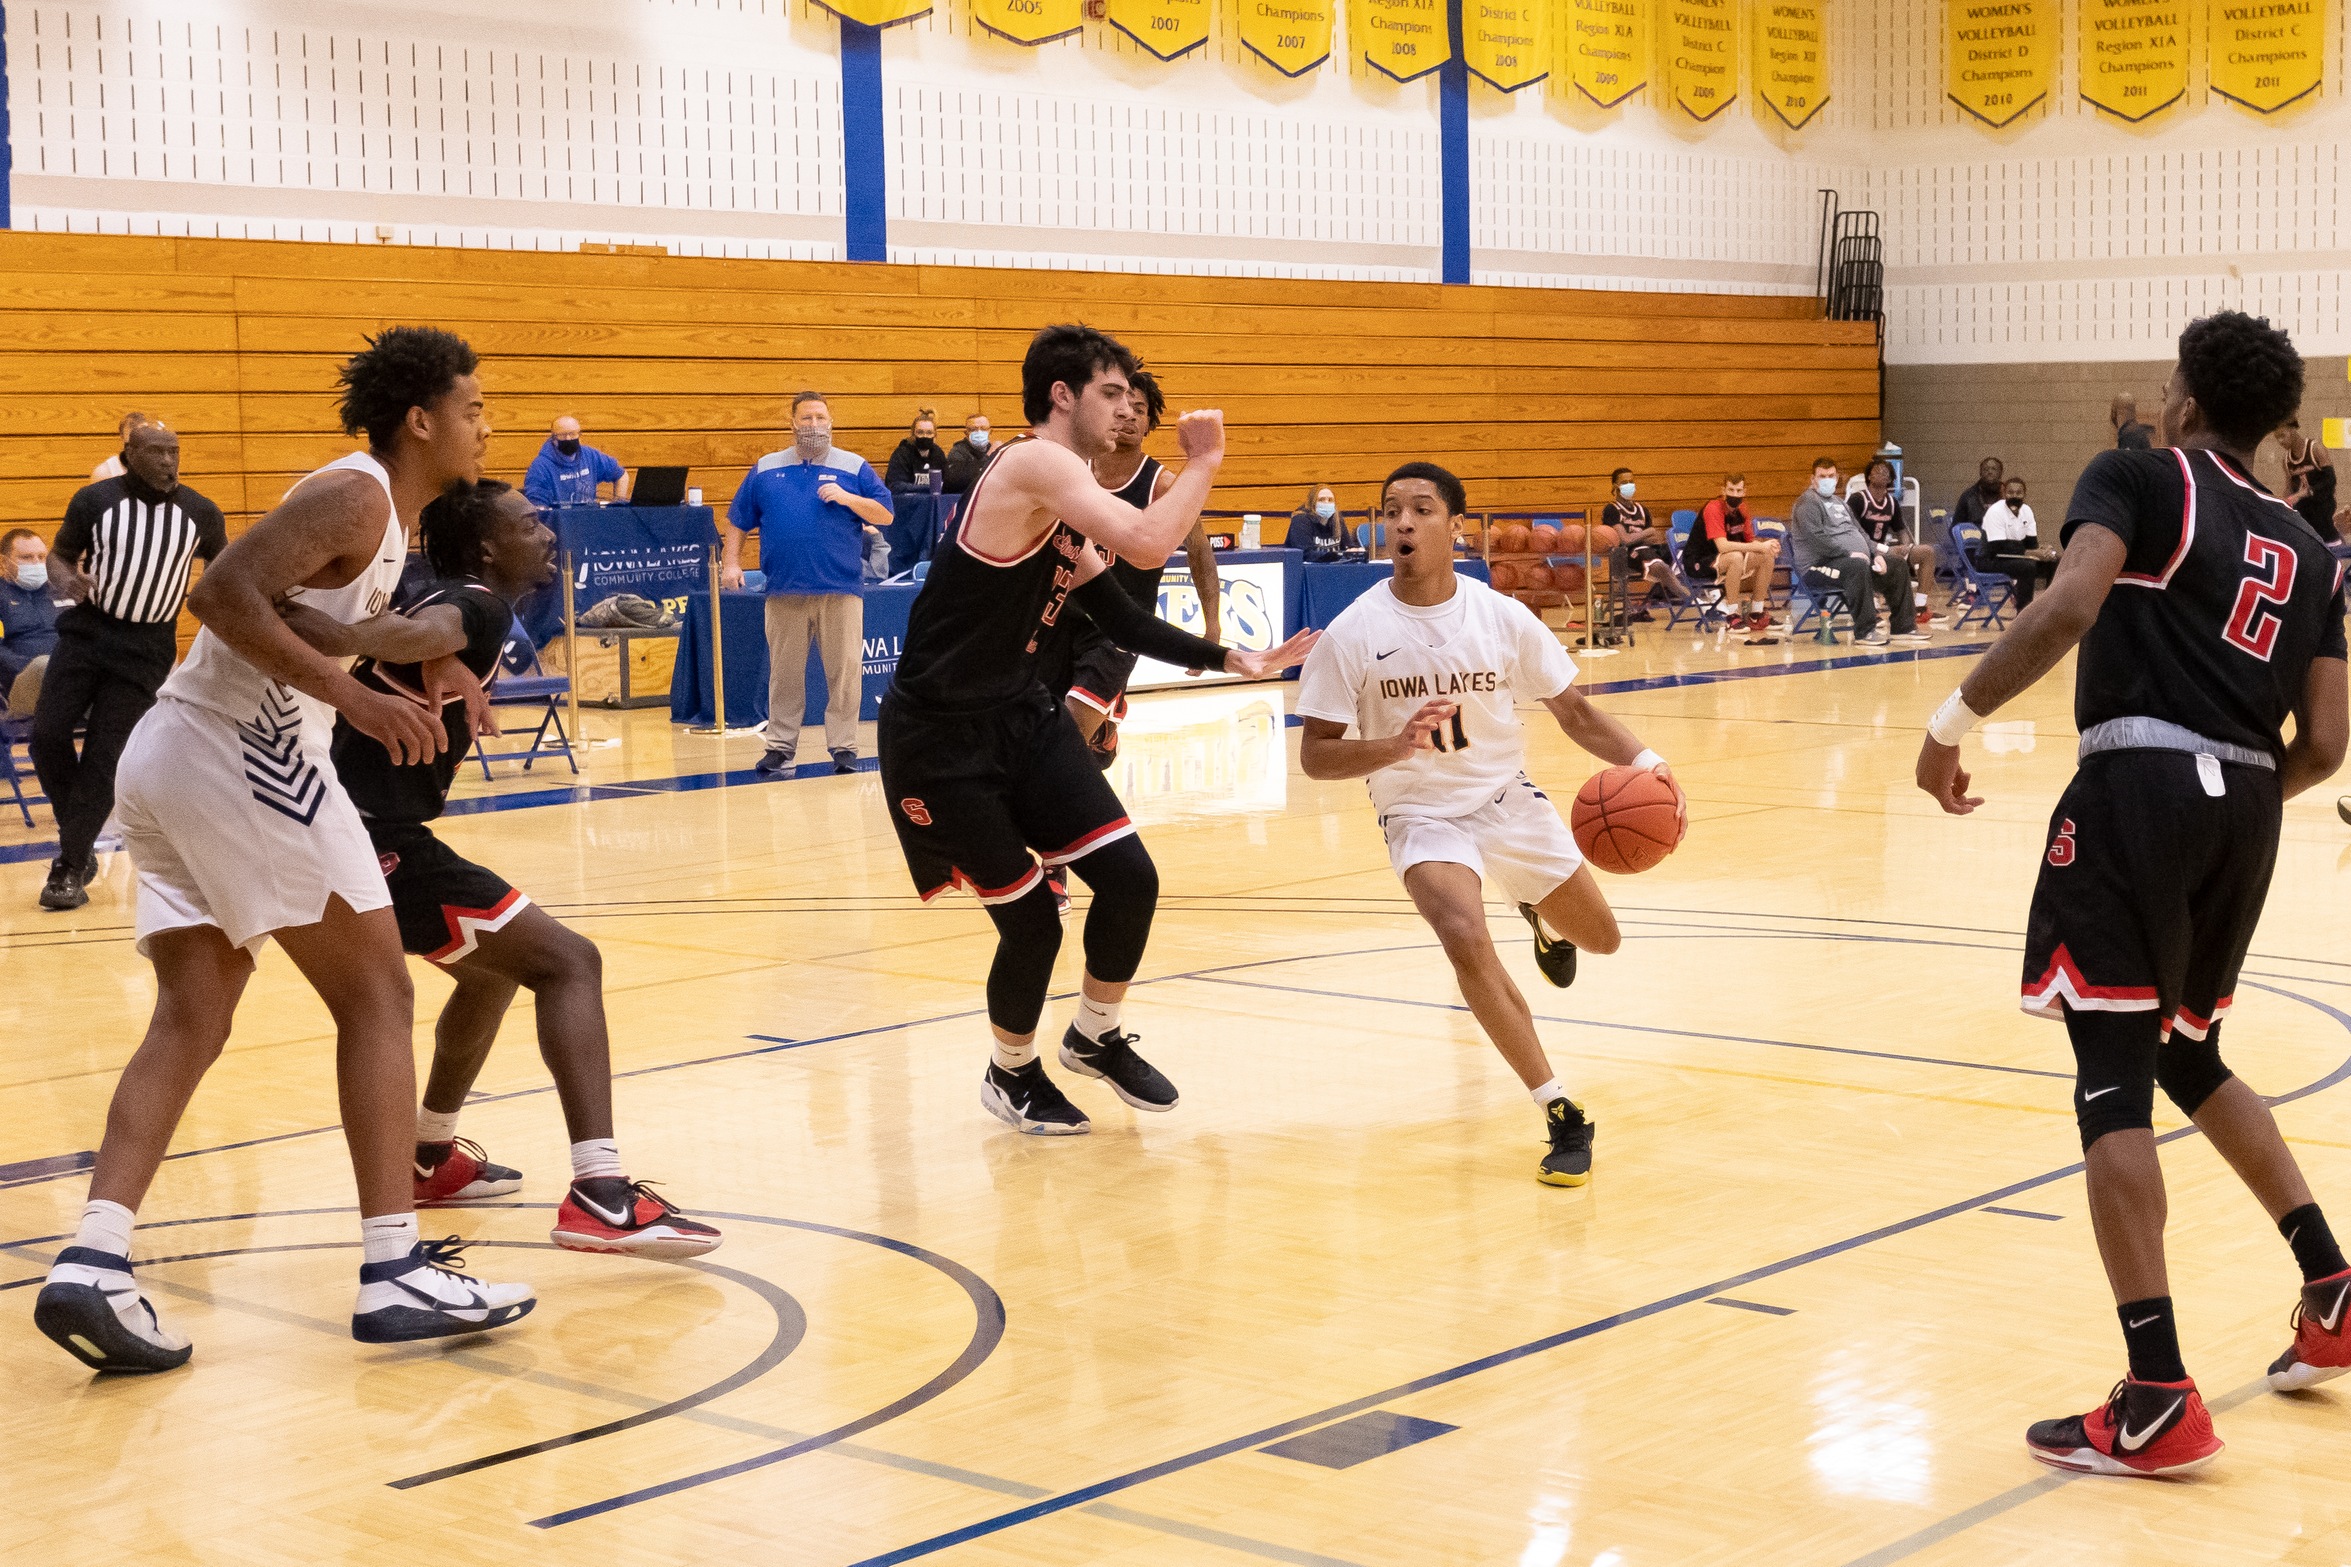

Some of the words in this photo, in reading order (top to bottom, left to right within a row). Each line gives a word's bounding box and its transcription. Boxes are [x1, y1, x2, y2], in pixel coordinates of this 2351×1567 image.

[1256, 3, 1325, 23] Champions
[1522, 9, 1530, 22] C
[1966, 3, 2033, 19] WOMEN'S
[2223, 1, 2312, 20] VOLLEYBALL
[1151, 15, 1180, 32] 2007
[2094, 13, 2178, 31] VOLLEYBALL
[1276, 34, 1306, 49] 2007
[1957, 24, 2037, 42] VOLLEYBALL
[2235, 26, 2285, 42] District
[2290, 24, 2301, 37] C
[1716, 40, 1726, 53] C
[1967, 48, 2013, 62] District
[2018, 45, 2029, 58] D
[2095, 40, 2144, 56] Region
[2150, 34, 2177, 49] XIA
[2227, 49, 2308, 65] Champions
[2099, 60, 2175, 75] Champions
[2255, 76, 2280, 89] 2011
[1984, 93, 2013, 107] 2010
[2123, 85, 2148, 98] 2011
[2221, 529, 2298, 662] 2
[1380, 675, 1429, 699] IOWA
[1435, 671, 1496, 696] LAKES
[901, 797, 933, 826] S
